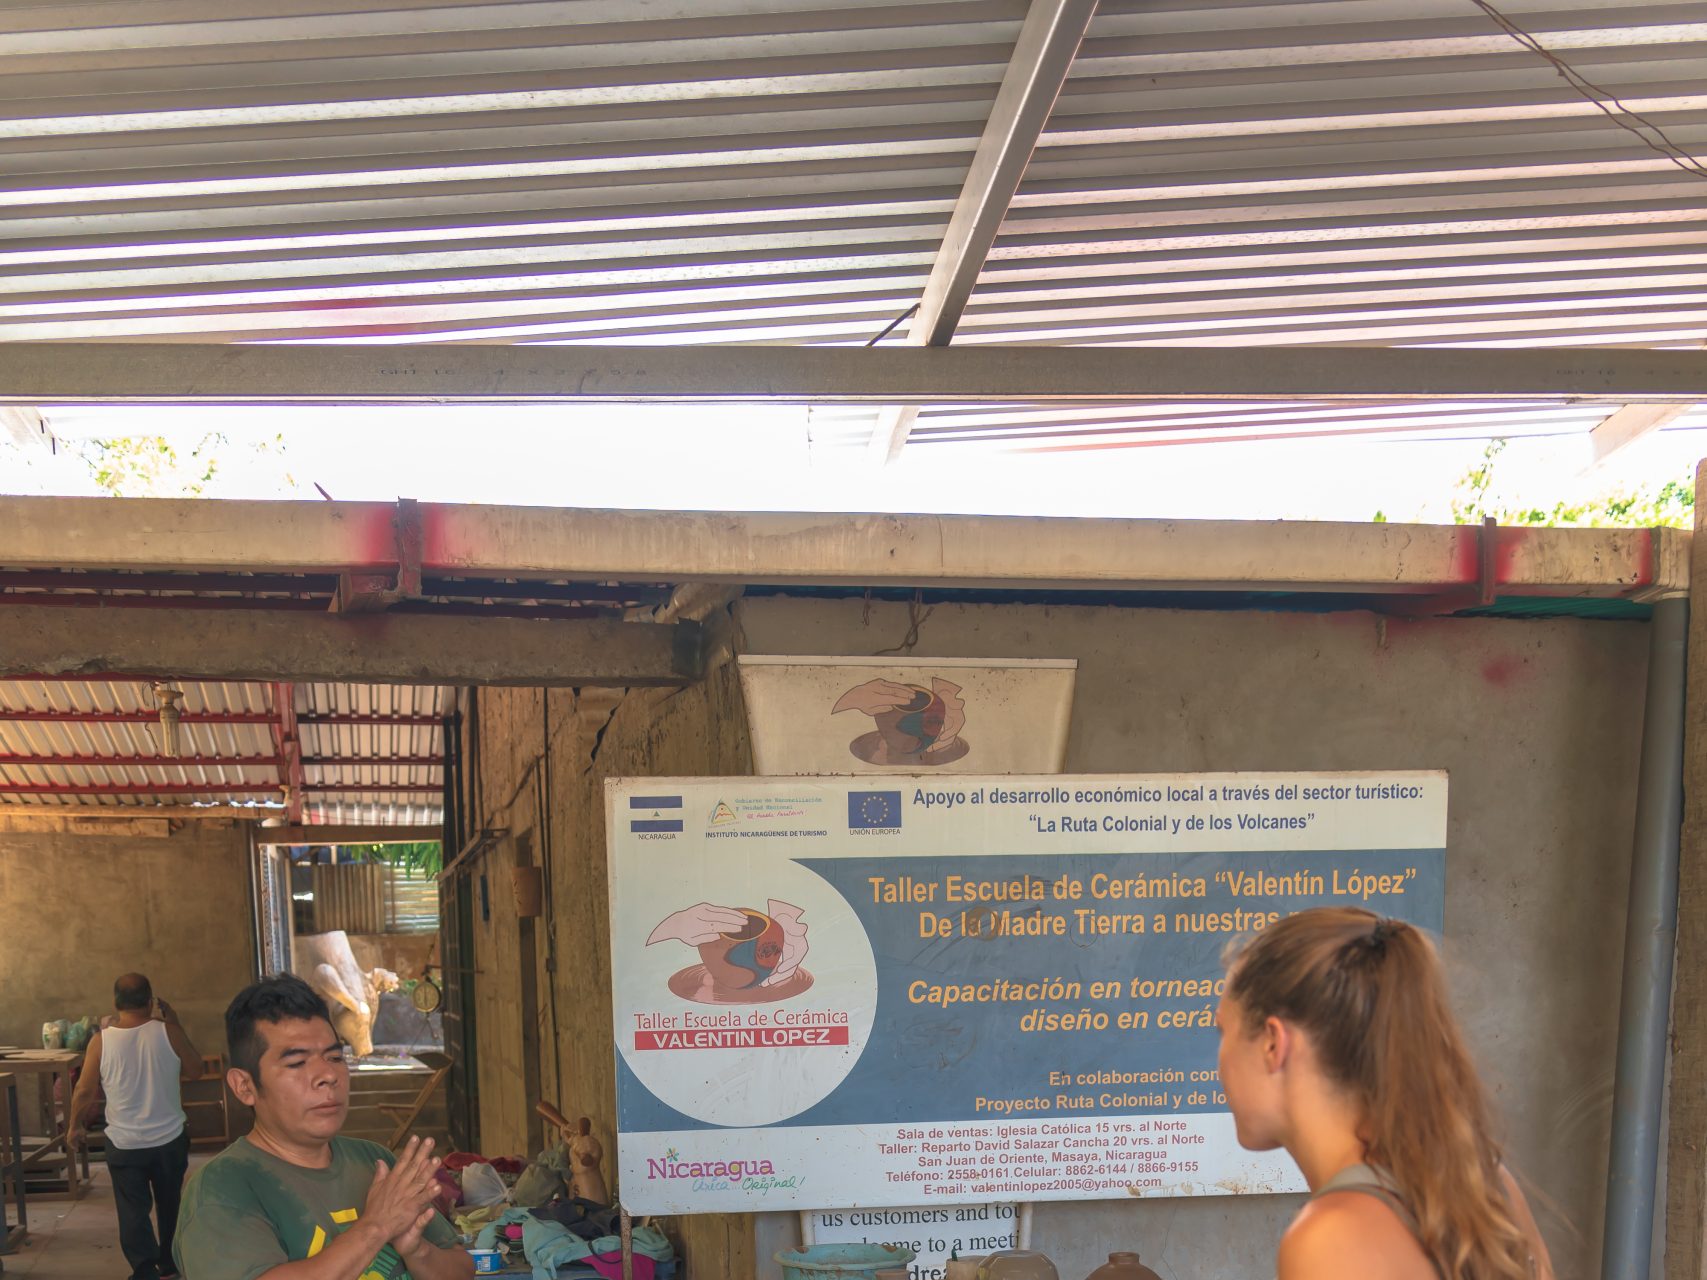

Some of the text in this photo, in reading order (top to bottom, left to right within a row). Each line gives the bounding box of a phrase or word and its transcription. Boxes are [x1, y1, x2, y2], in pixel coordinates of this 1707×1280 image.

[913, 783, 1423, 808] Apoyo al desarrollo económico local a través del sector turístico:
[850, 827, 900, 836] UNIÓN EUROPEA
[1029, 812, 1314, 834] “La Ruta Colonial y de los Volcanes”
[869, 868, 1416, 903] Taller Escuela de Cerámica “Valentín López”
[920, 907, 1280, 938] De la Madre Tierra a nuestras
[908, 975, 1081, 1008] Capacitación
[1089, 980, 1122, 999] en
[634, 1008, 848, 1029] Taller Escuela de Cerámica
[1020, 1008, 1109, 1033] diseño
[1117, 1009, 1147, 1030] en
[653, 1028, 830, 1048] VALENTIN LOPEZ
[1049, 1069, 1219, 1086] En colaboración con
[975, 1096, 1050, 1115] Proyecto
[1056, 1094, 1094, 1109] Ruta
[1100, 1092, 1168, 1108] Colonial
[1172, 1095, 1182, 1109] y
[1187, 1091, 1206, 1105] de
[897, 1120, 1186, 1139] Sala de ventas: Iglesia Católica 15 vrs. al Norte
[879, 1133, 1204, 1155] Taller: Reparto David Salazar Cancha 20 vrs. al Norte
[646, 1157, 774, 1181] Nicaragua
[918, 1149, 1167, 1167] San Juan de Oriente, Masaya, Nicaragua
[886, 1162, 1198, 1182] Teléfono: 2558-0161 Celular: 8862-6144 / 8866-9155
[924, 1176, 1161, 1195] E-mail: valentinlopez2005@yahoo.com
[822, 1214, 843, 1227] us
[850, 1208, 948, 1225] customers
[956, 1204, 988, 1222] and
[929, 1237, 946, 1252] to
[953, 1238, 961, 1250] a
